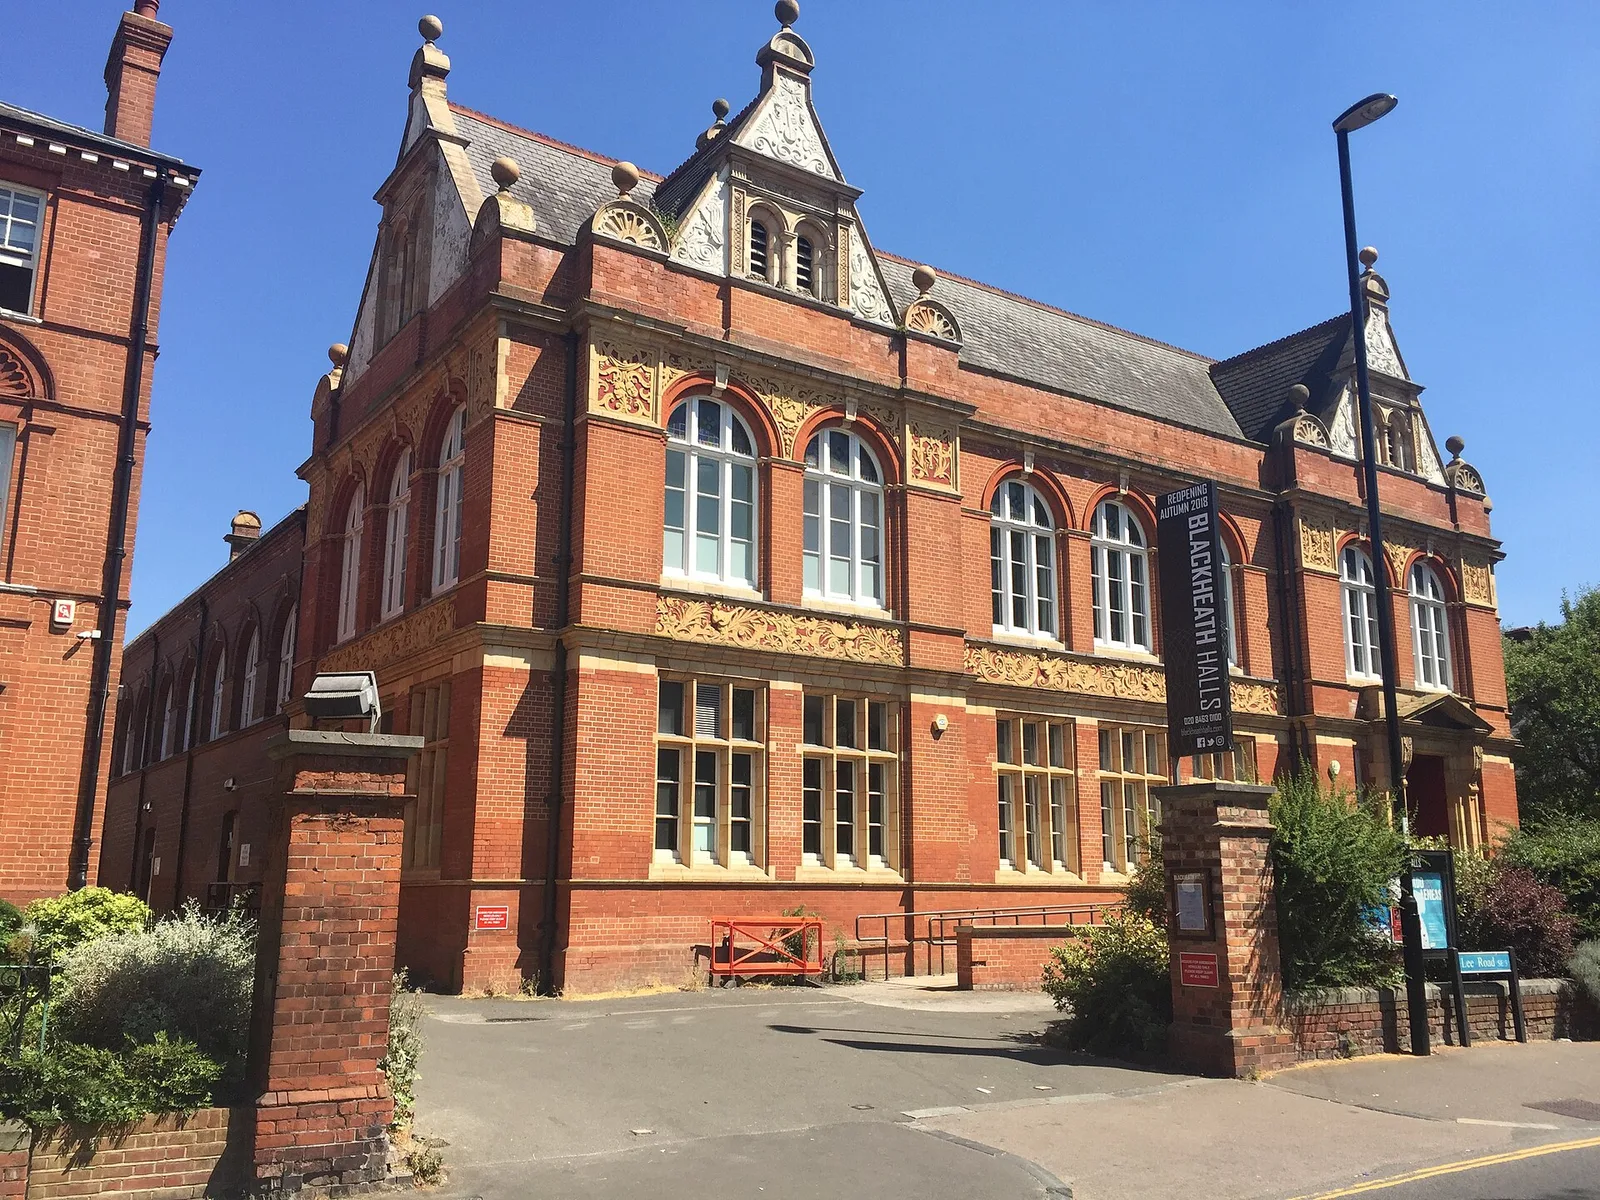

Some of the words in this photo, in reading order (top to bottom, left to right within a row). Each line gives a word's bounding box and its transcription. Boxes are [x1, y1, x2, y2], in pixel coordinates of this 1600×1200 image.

[1167, 483, 1208, 506] REOPENING
[1160, 501, 1190, 520] AUTUMN
[1190, 495, 1209, 511] 2018
[1188, 512, 1217, 645] BLACKHEATH
[1196, 650, 1221, 710] HALLS
[1183, 716, 1195, 725] 020
[1460, 957, 1475, 968] Lee
[1477, 956, 1496, 968] Road
